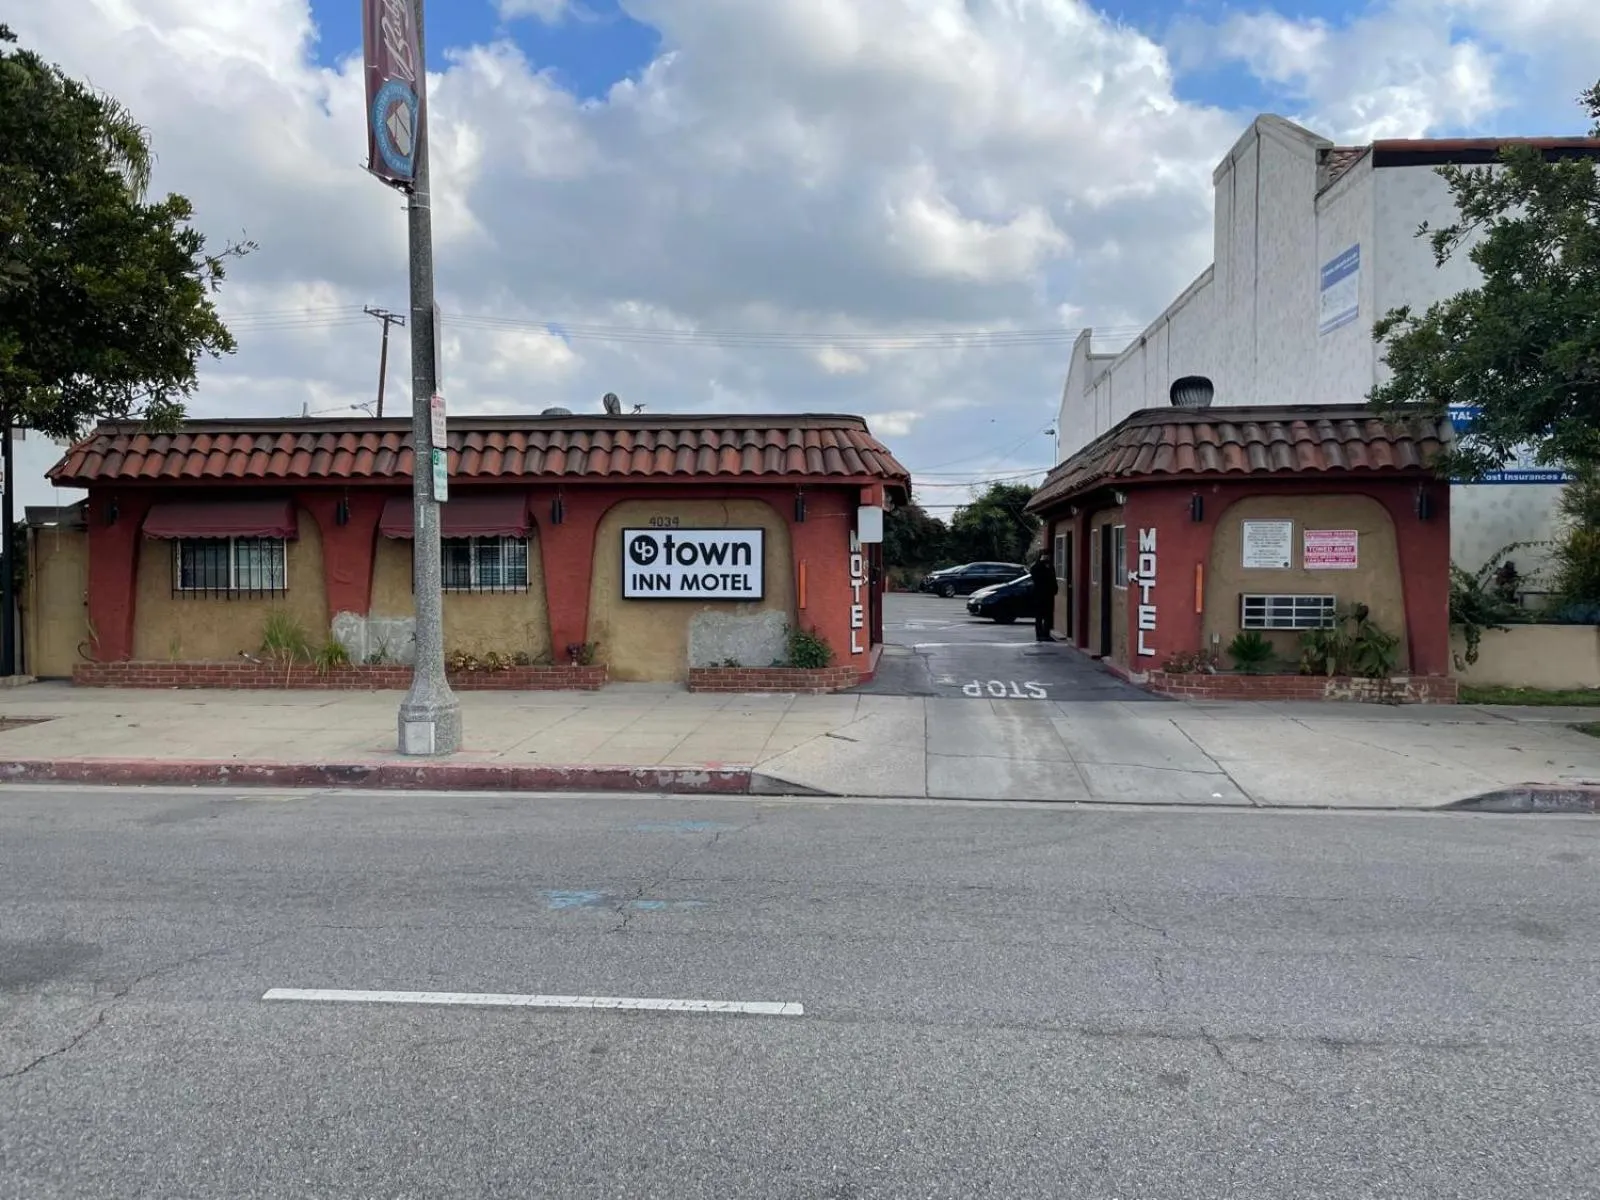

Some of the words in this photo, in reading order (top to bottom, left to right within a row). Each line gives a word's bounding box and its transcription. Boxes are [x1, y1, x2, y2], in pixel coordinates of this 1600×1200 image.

[1447, 410, 1473, 421] TAL
[1504, 471, 1558, 481] Insurances
[649, 516, 680, 527] 4034
[663, 534, 751, 566] town
[632, 573, 671, 591] INN
[680, 573, 753, 591] MOTEL
[850, 530, 864, 654] MOTEL
[1138, 527, 1156, 656] MOTEL
[962, 680, 1054, 699] STOP
